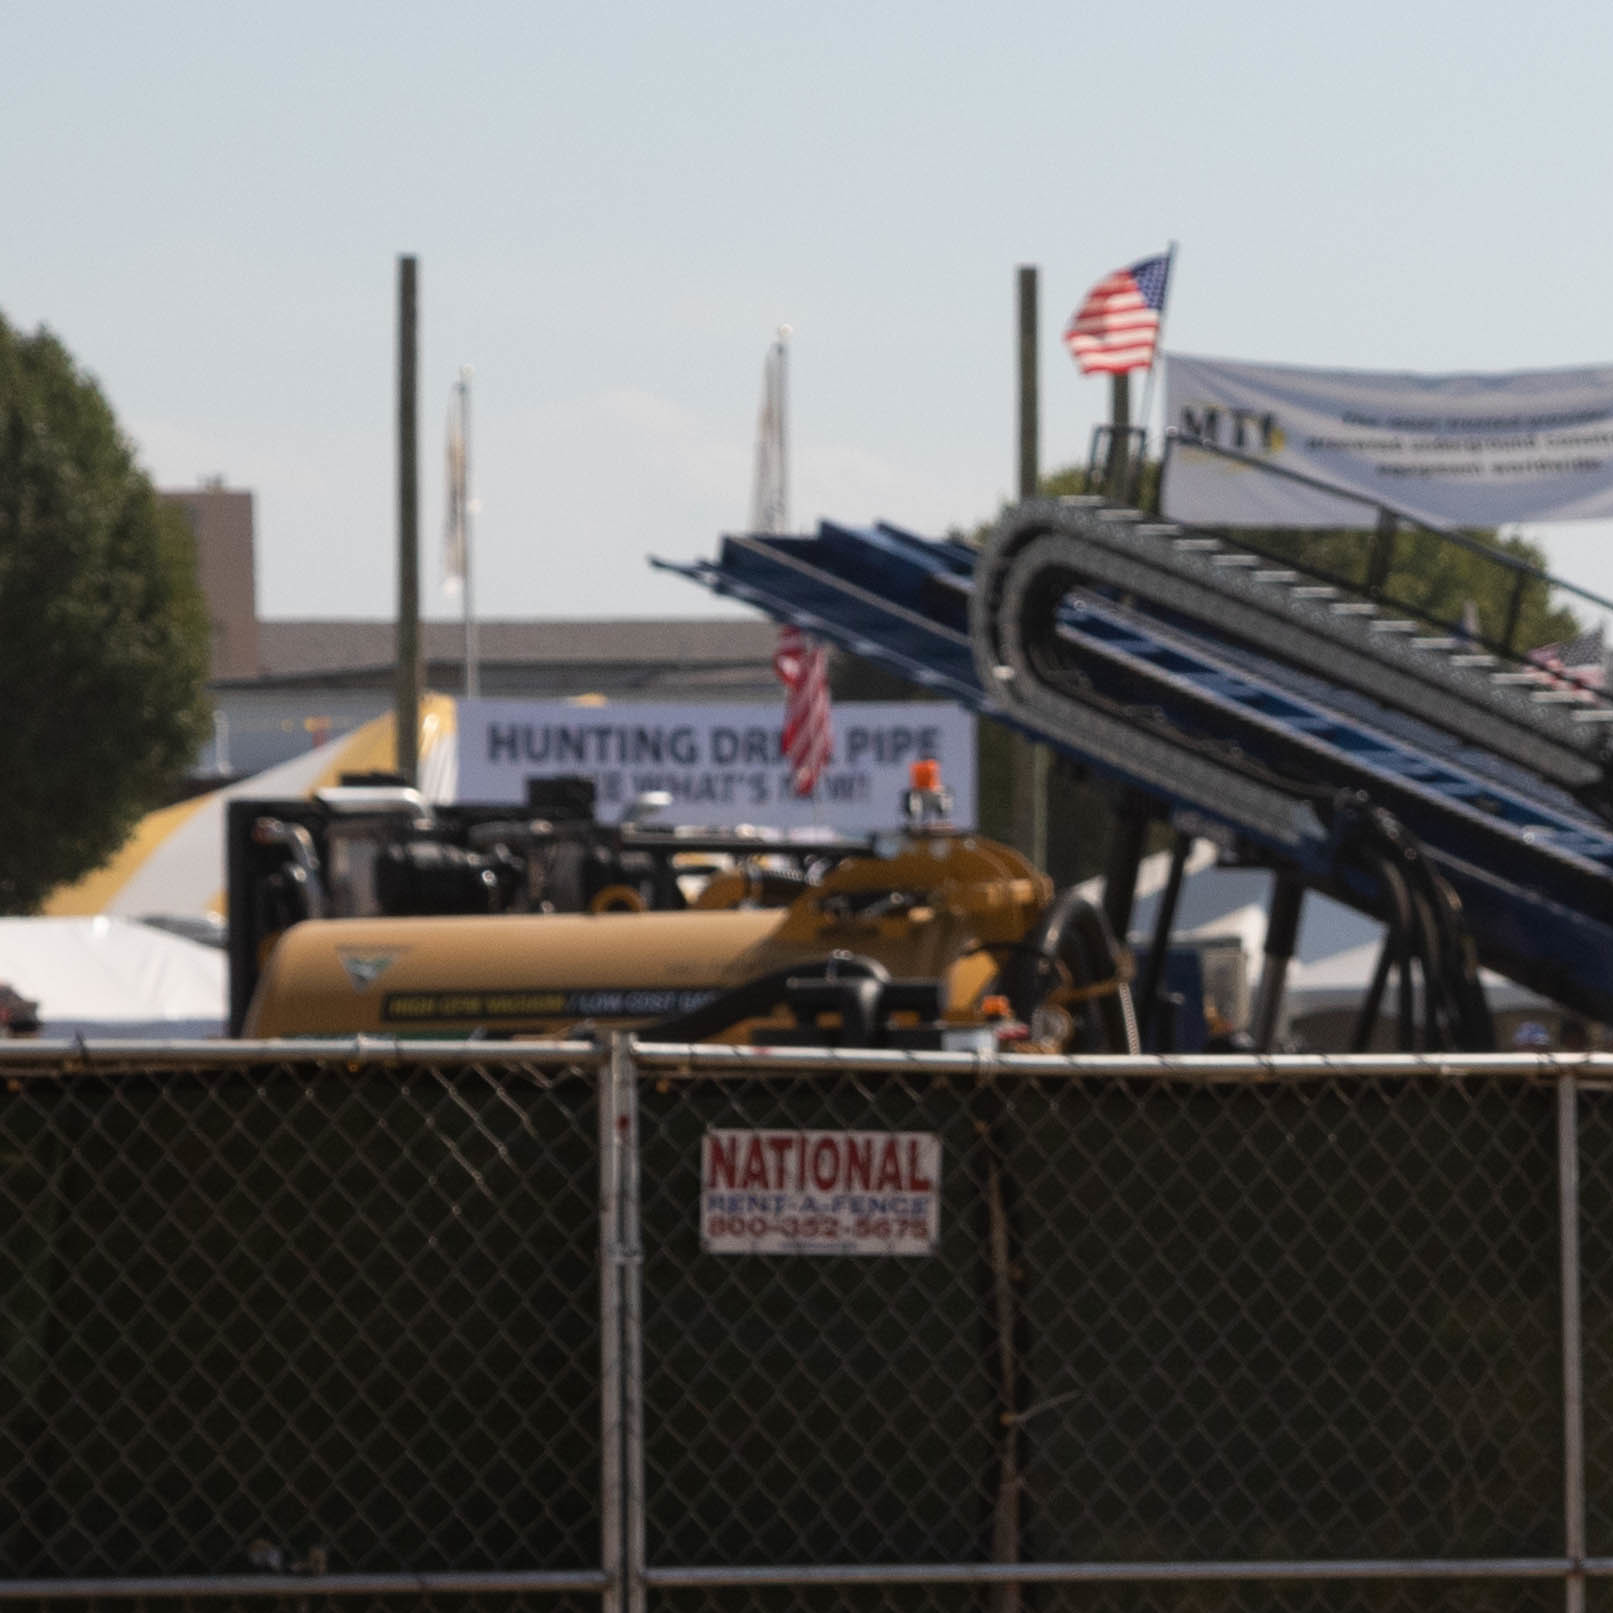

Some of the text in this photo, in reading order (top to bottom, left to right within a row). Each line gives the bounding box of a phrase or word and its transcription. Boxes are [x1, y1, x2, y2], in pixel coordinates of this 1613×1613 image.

[488, 724, 698, 765] HUNTING
[846, 726, 941, 764] PIPE
[708, 1134, 932, 1192] NATIONAL
